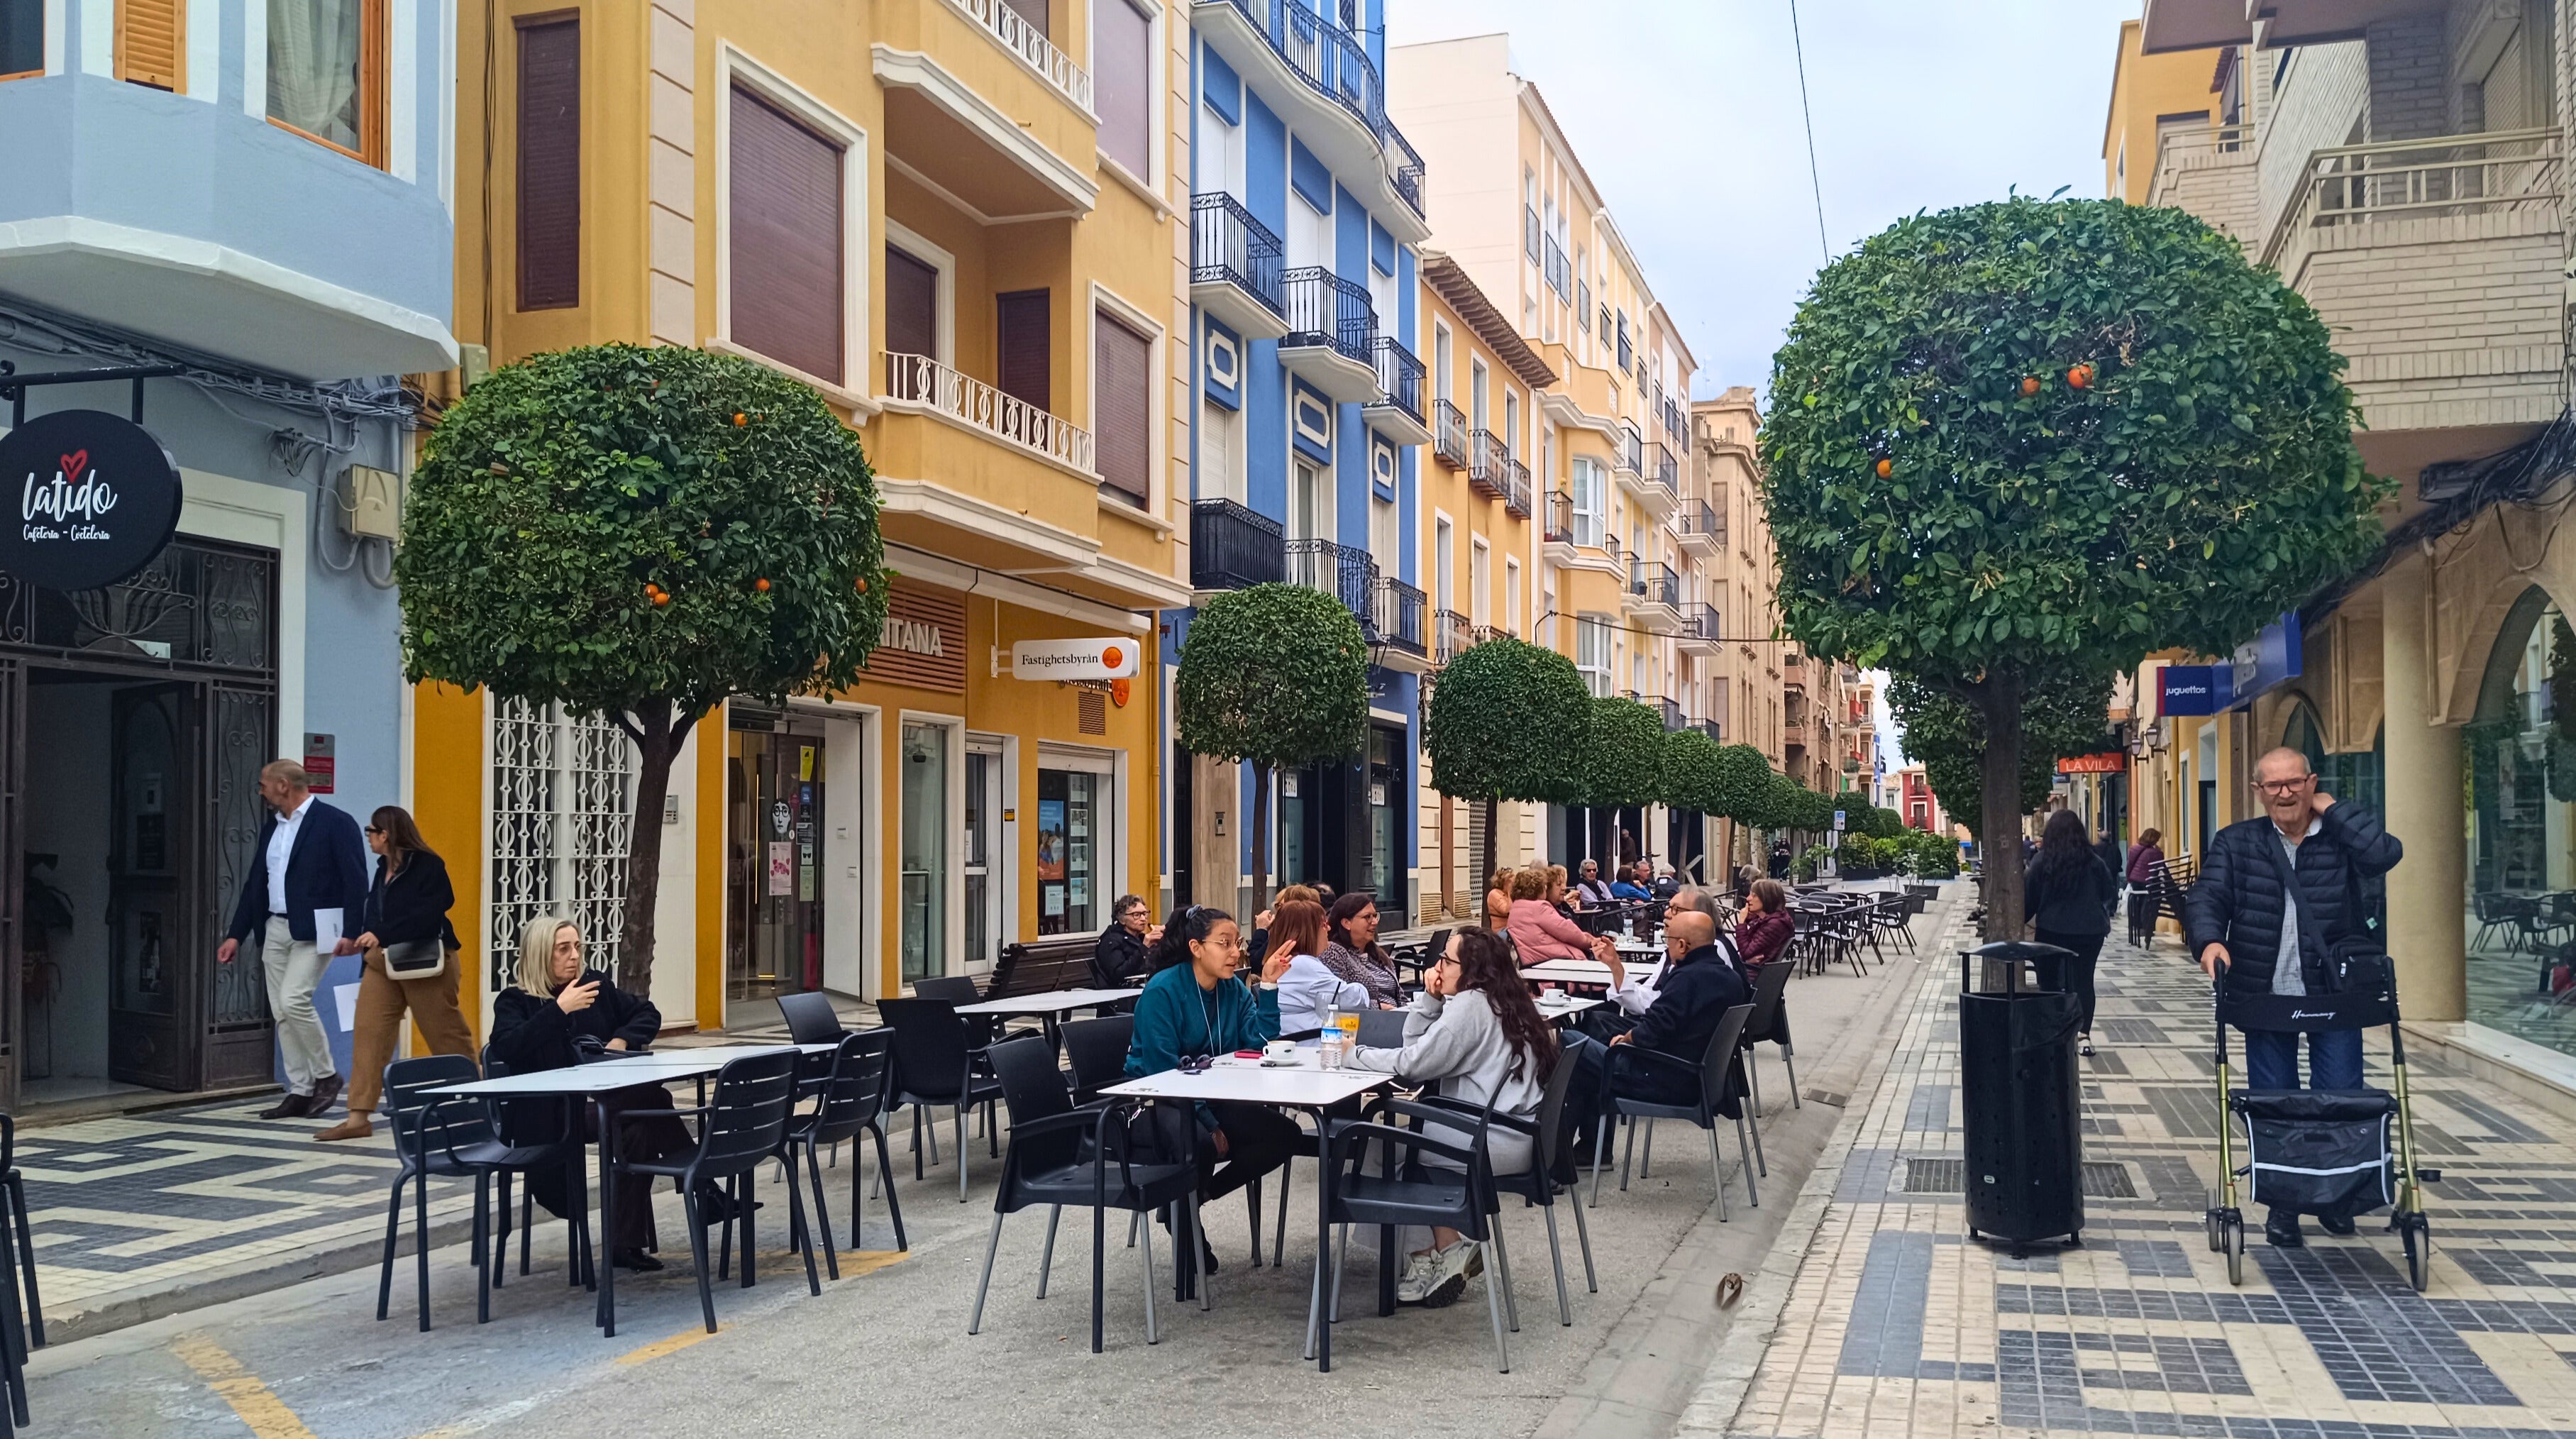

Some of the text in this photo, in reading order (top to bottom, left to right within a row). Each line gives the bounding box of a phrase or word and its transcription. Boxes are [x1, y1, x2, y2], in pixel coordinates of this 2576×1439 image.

[1022, 654, 1098, 668] Fastighetsbyrån
[2165, 685, 2206, 696] juguettos
[2066, 760, 2116, 772] LA VILA
